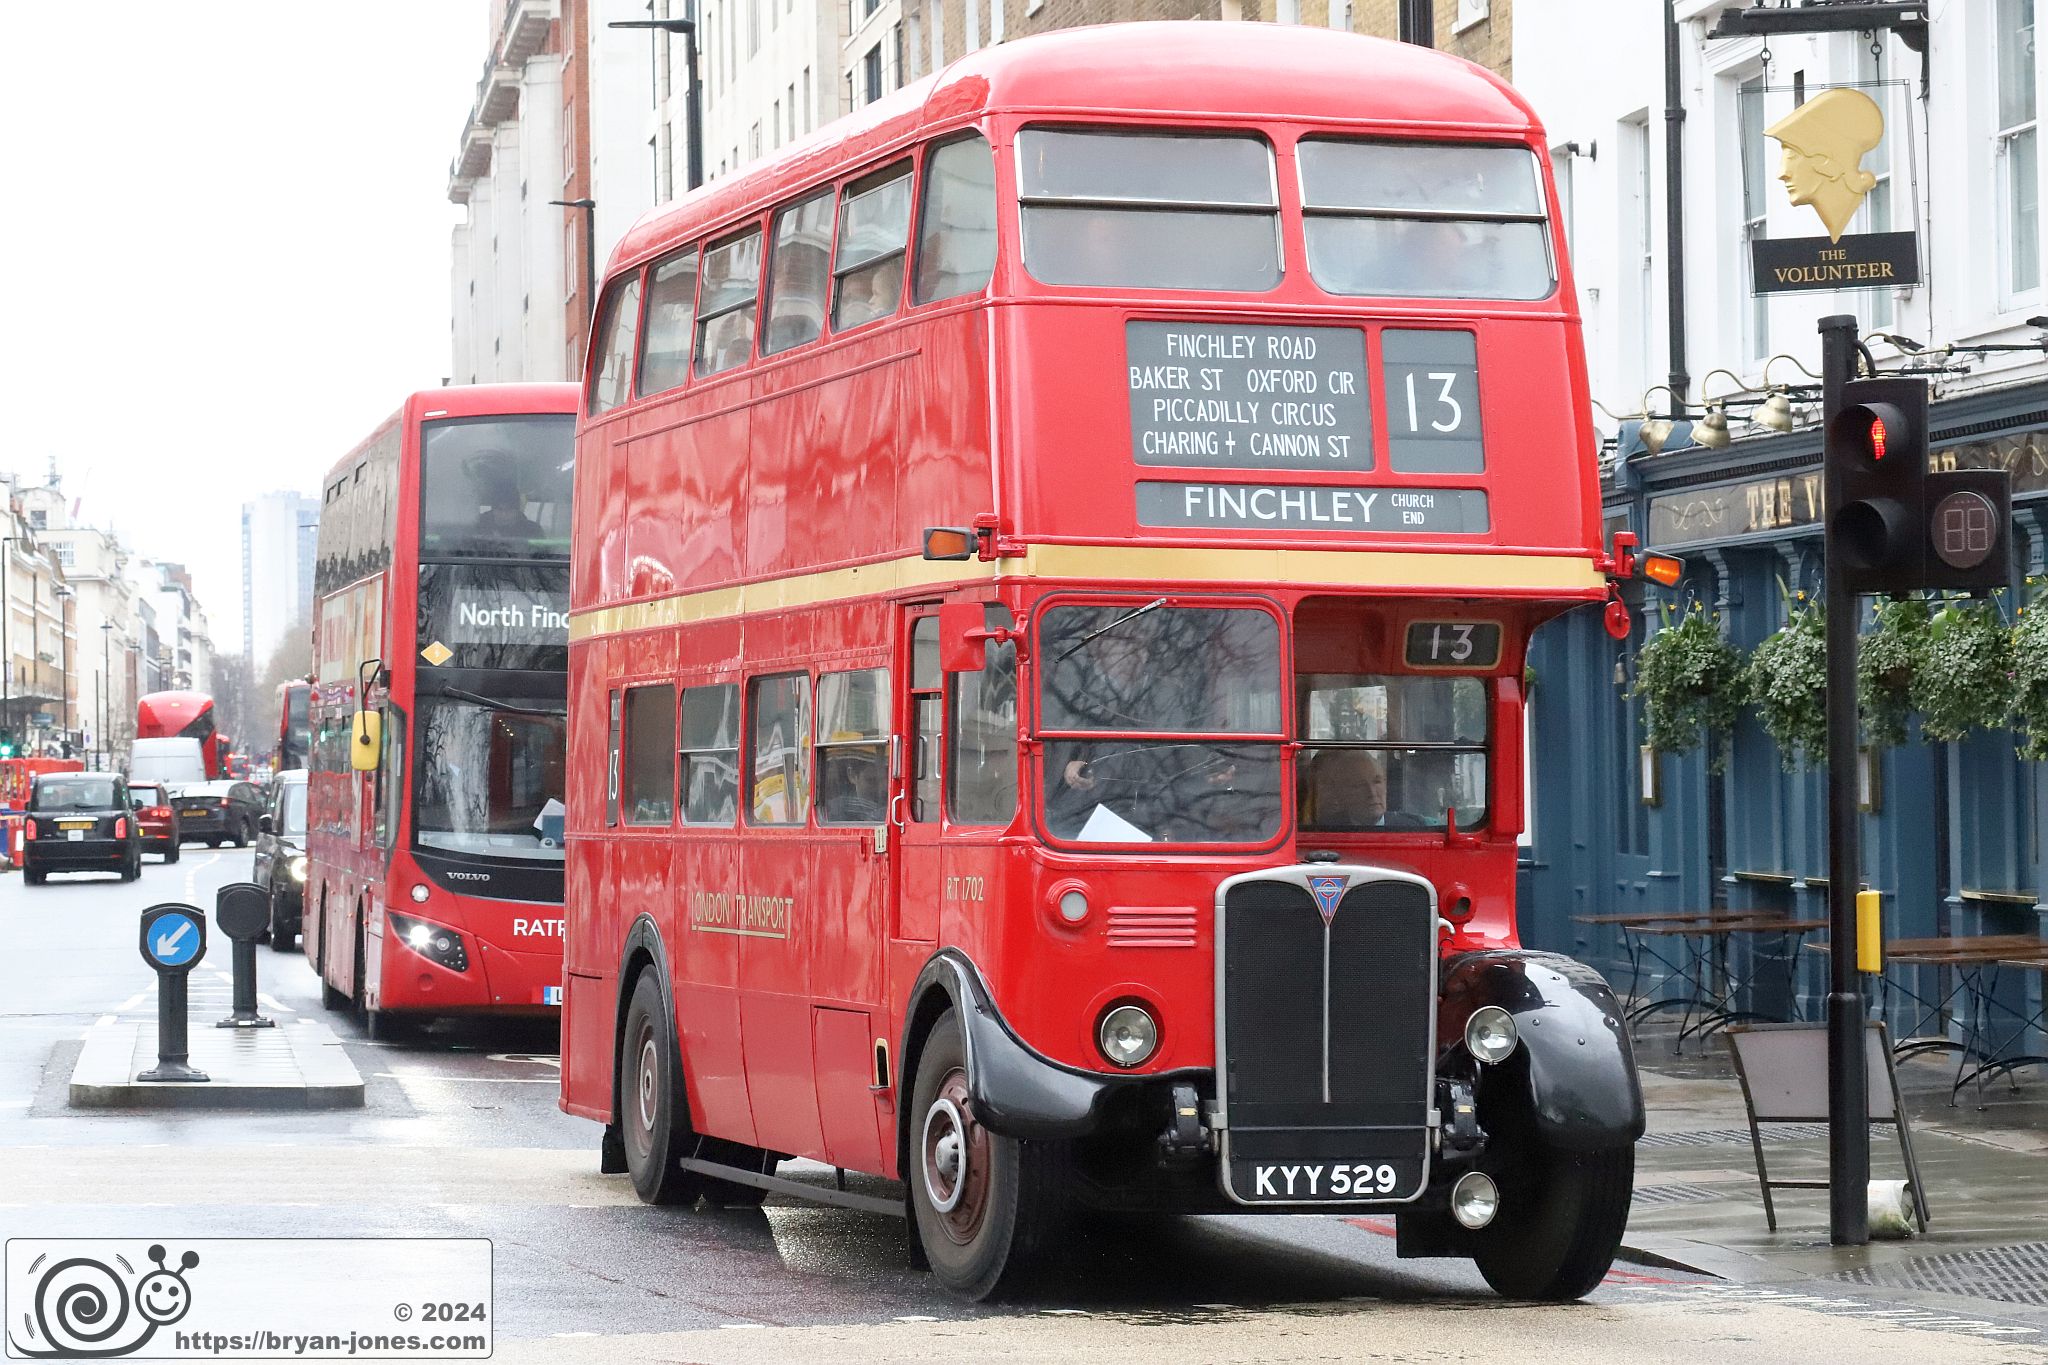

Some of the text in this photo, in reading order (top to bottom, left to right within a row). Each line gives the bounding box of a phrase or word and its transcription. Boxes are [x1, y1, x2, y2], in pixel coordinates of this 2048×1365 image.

[1819, 249, 1847, 261] THE
[1774, 262, 1895, 284] VOLUNTEER
[1166, 333, 1316, 360] FINCHLEY ROAD
[1129, 366, 1355, 395] BAKER ST OXFORD CIR
[1153, 399, 1336, 426] PICCADILLY CIRCUS
[1405, 372, 1462, 433] 13
[1143, 431, 1218, 455] CHARING
[1250, 433, 1320, 457] CANNON
[1328, 435, 1351, 458] ST
[1185, 486, 1378, 523] FINCHLEY
[1391, 493, 1434, 509] CHURCH
[1747, 478, 1792, 530] THE
[1403, 511, 1425, 525] END
[460, 602, 524, 627] North
[1431, 624, 1475, 660] 13
[446, 872, 491, 881] VOLVO
[946, 876, 984, 901] RT 1702
[691, 891, 794, 939] LONDON TRANSPORT
[1255, 1164, 1397, 1196] KYY 529
